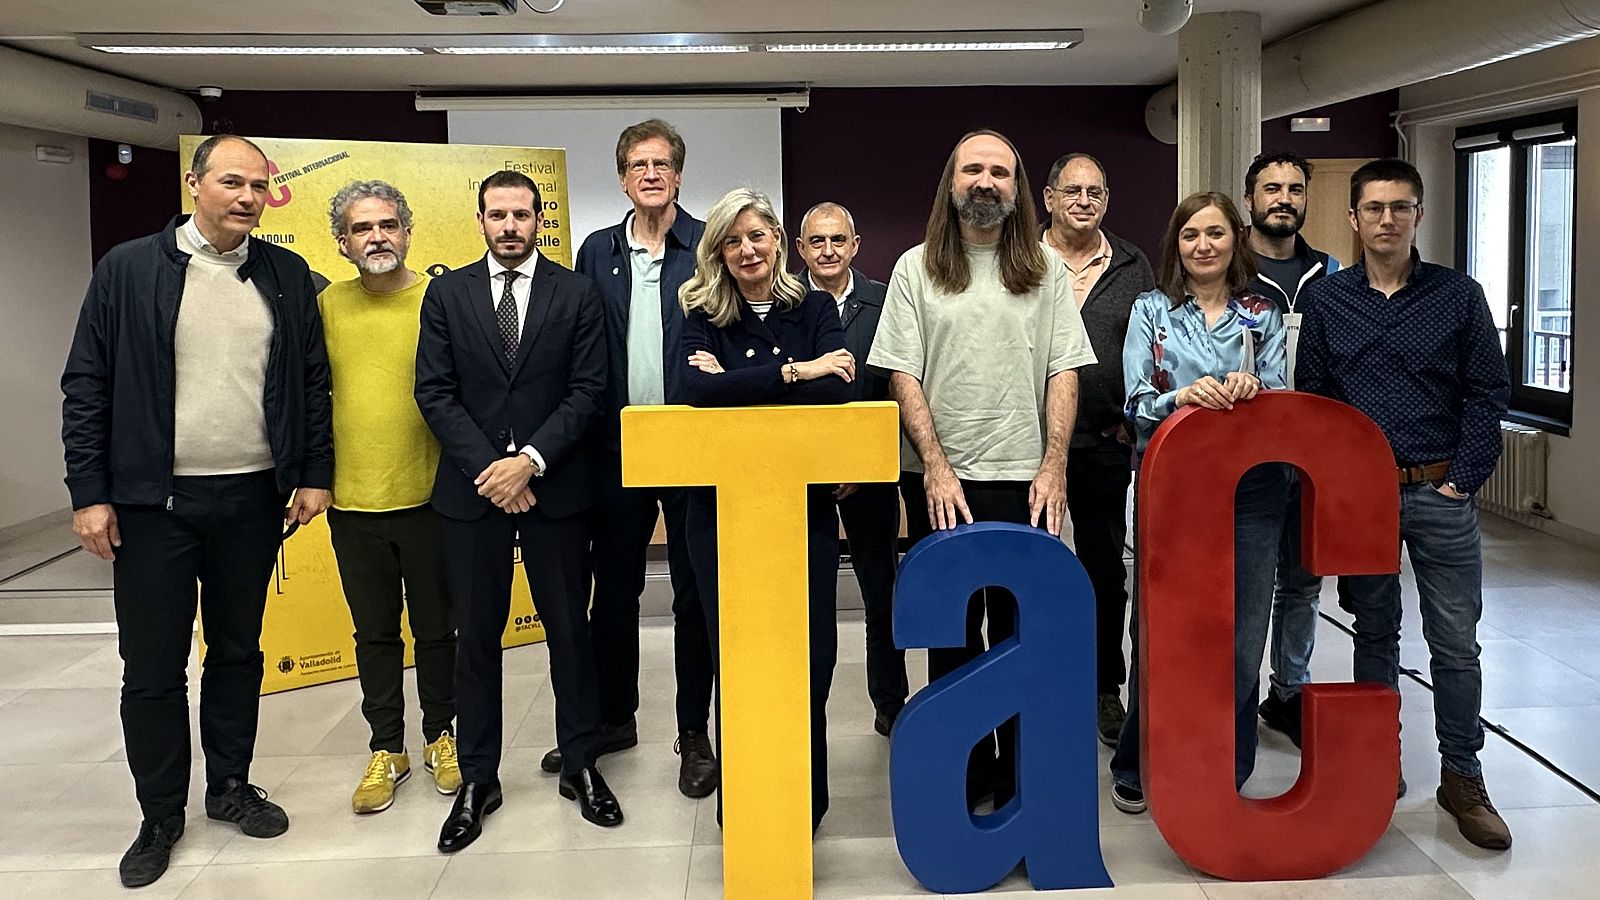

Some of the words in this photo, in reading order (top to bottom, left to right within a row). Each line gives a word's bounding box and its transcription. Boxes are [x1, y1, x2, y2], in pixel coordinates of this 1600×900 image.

[273, 169, 302, 185] FESTIVAL
[302, 151, 350, 174] INTERNACIONAL
[504, 161, 556, 174] Festival
[535, 235, 560, 247] alle
[299, 655, 341, 669] Valladolid
